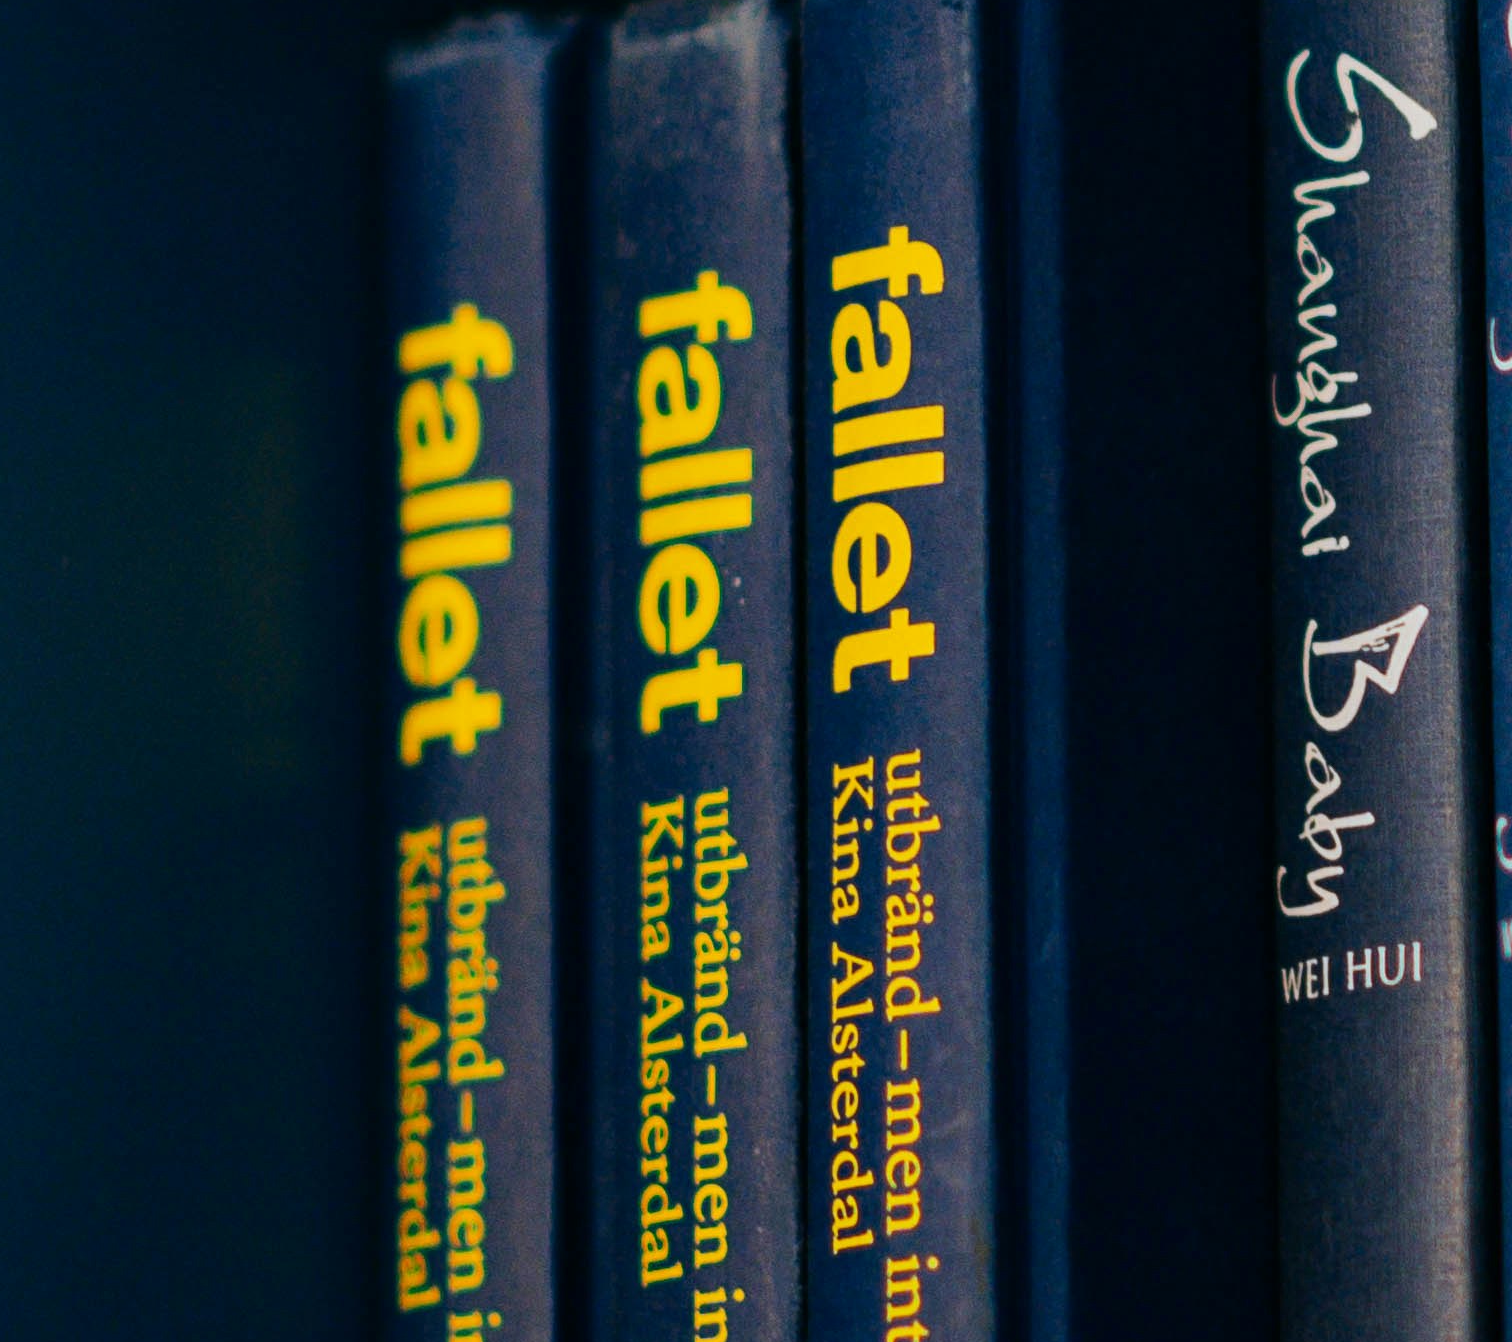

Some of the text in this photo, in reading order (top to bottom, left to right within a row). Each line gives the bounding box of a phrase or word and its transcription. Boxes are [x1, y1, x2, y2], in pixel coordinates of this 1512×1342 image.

[400, 304, 512, 763] fallet
[639, 271, 752, 733] fallet
[832, 226, 945, 692] fallet
[1273, 50, 1437, 915] Shanghai Baby
[400, 826, 441, 1309] Kina Alsterdal
[641, 797, 683, 1286] Kina Alsterdal
[831, 758, 874, 1252] Kina Alsterdal
[1279, 942, 1421, 999] WEI HUI
